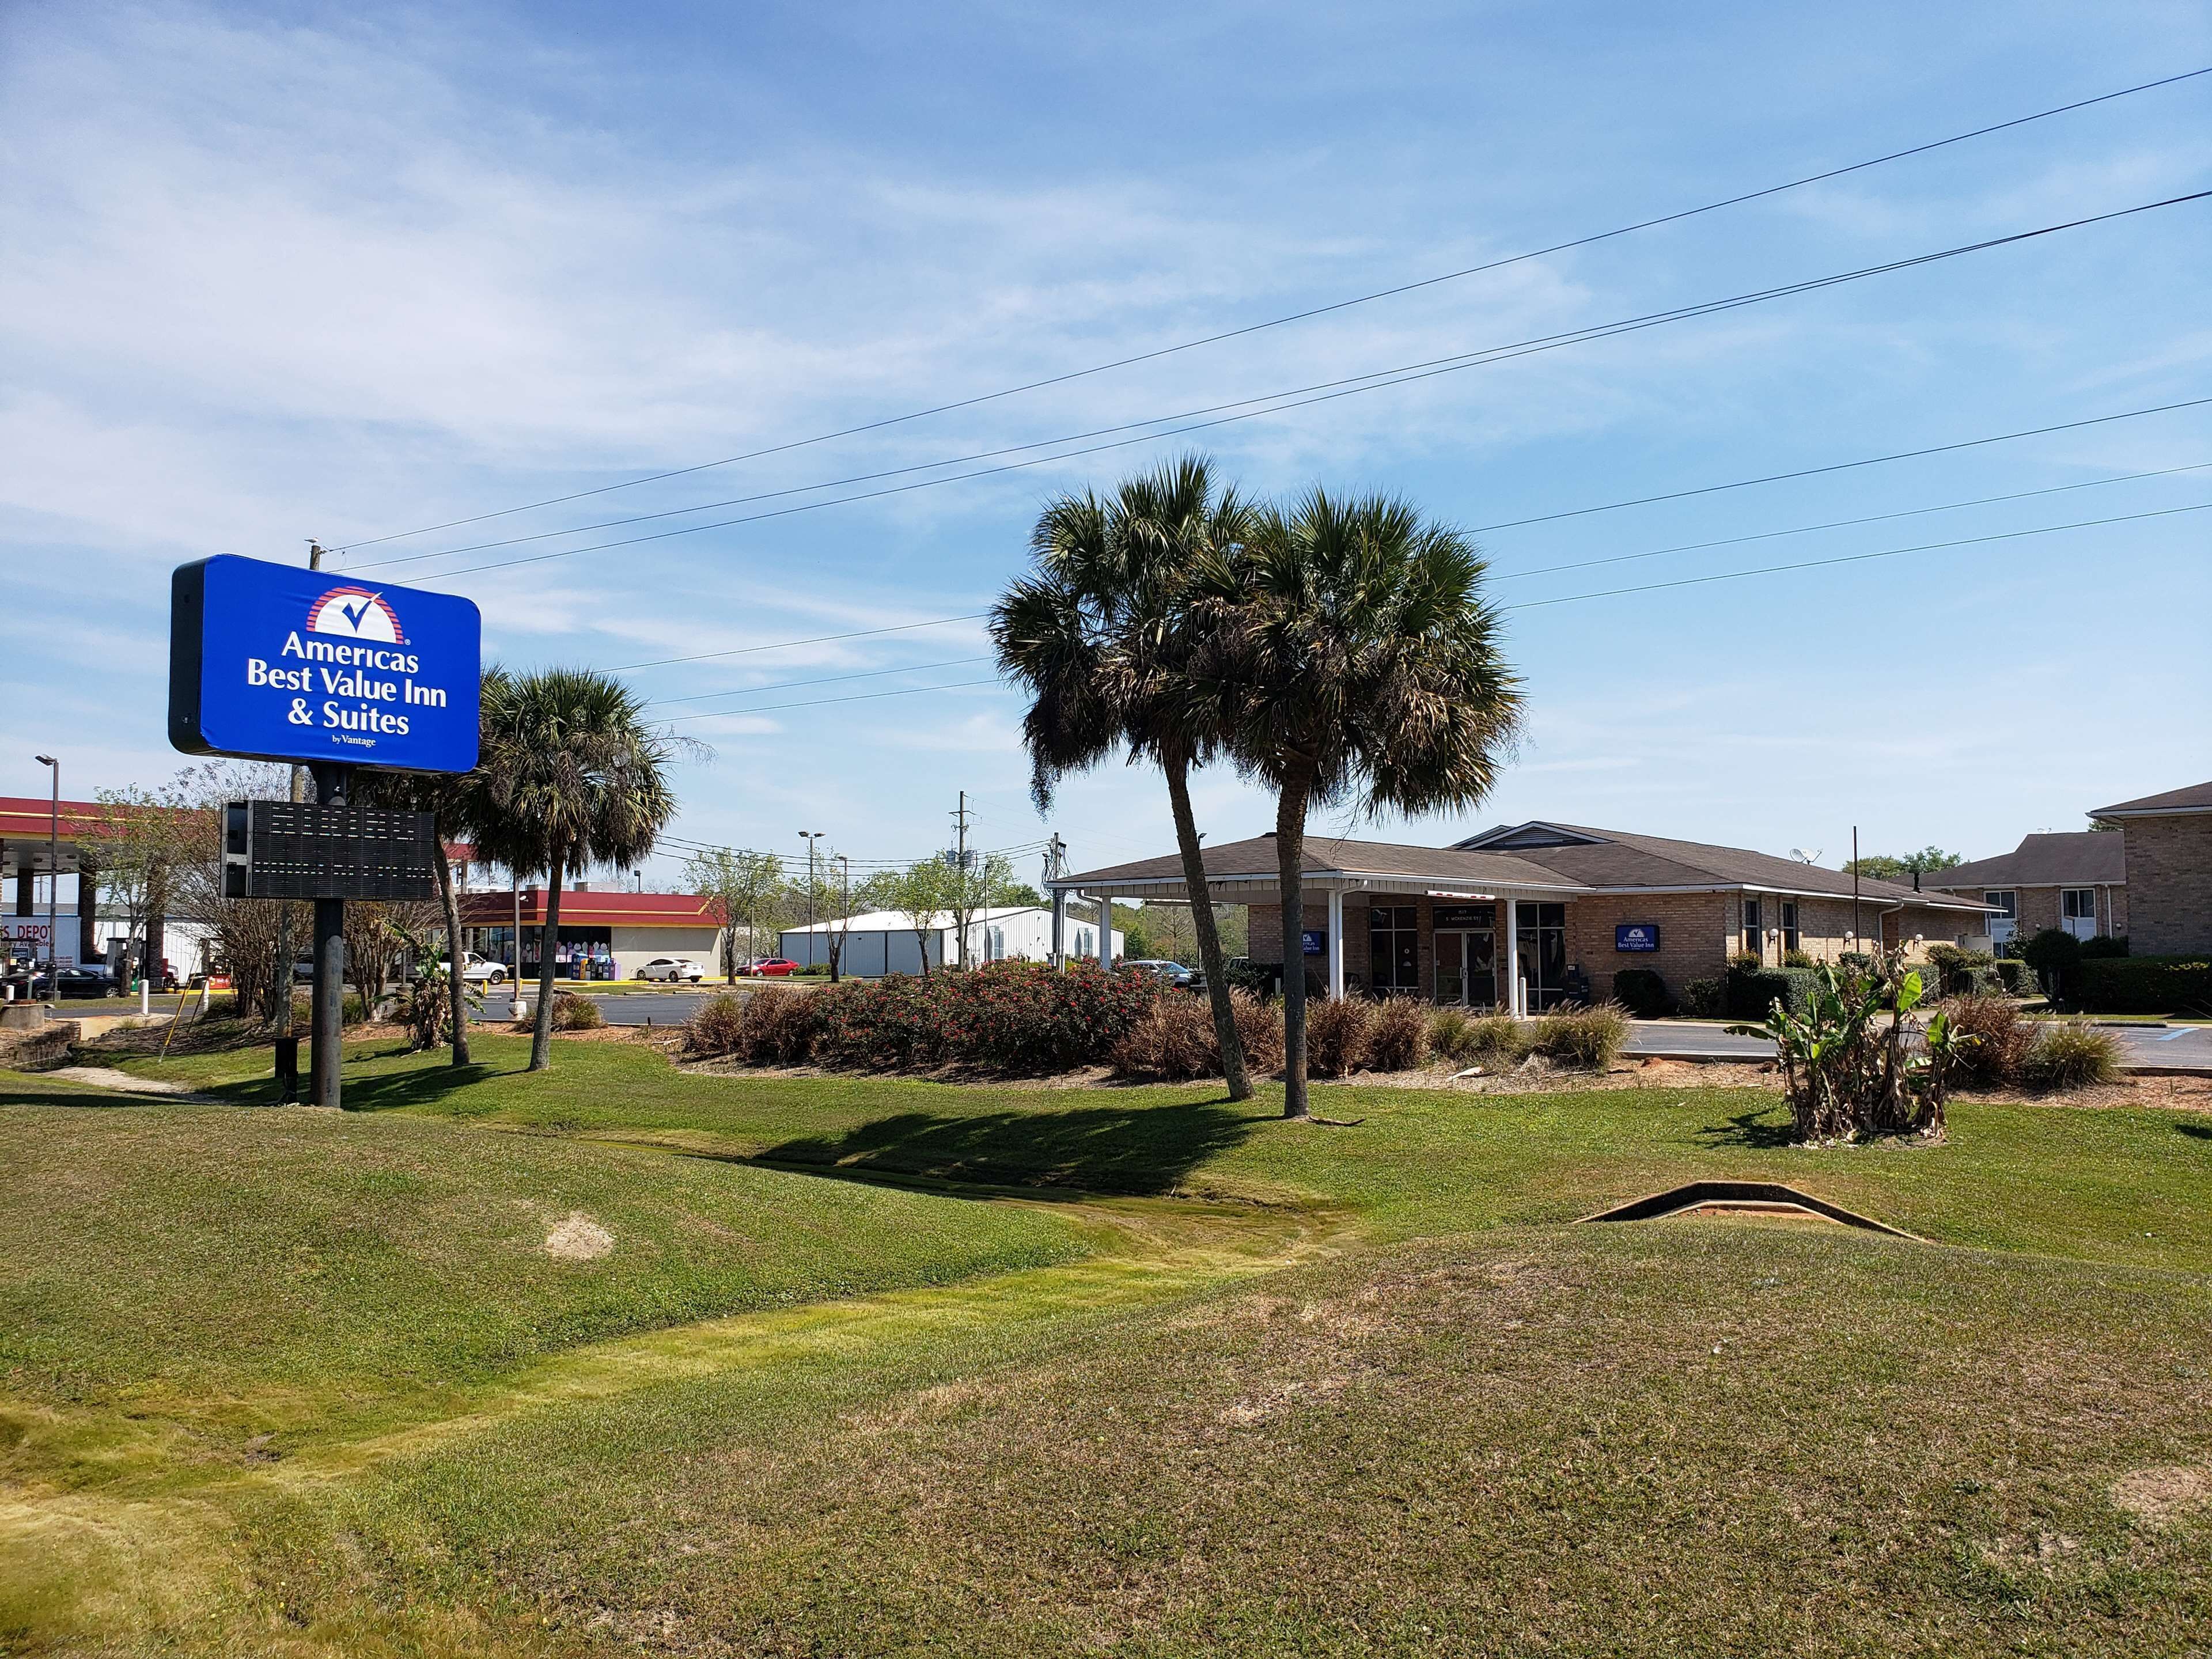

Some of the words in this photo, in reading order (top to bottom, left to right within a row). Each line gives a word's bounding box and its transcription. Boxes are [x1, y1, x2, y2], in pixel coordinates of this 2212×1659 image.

[281, 631, 419, 673] Americas
[248, 658, 313, 692] Best
[320, 667, 397, 702] Value
[405, 678, 446, 707] Inn
[288, 698, 313, 725] &
[323, 700, 410, 735] Suites
[332, 734, 341, 744] by
[341, 734, 377, 748] Vantage
